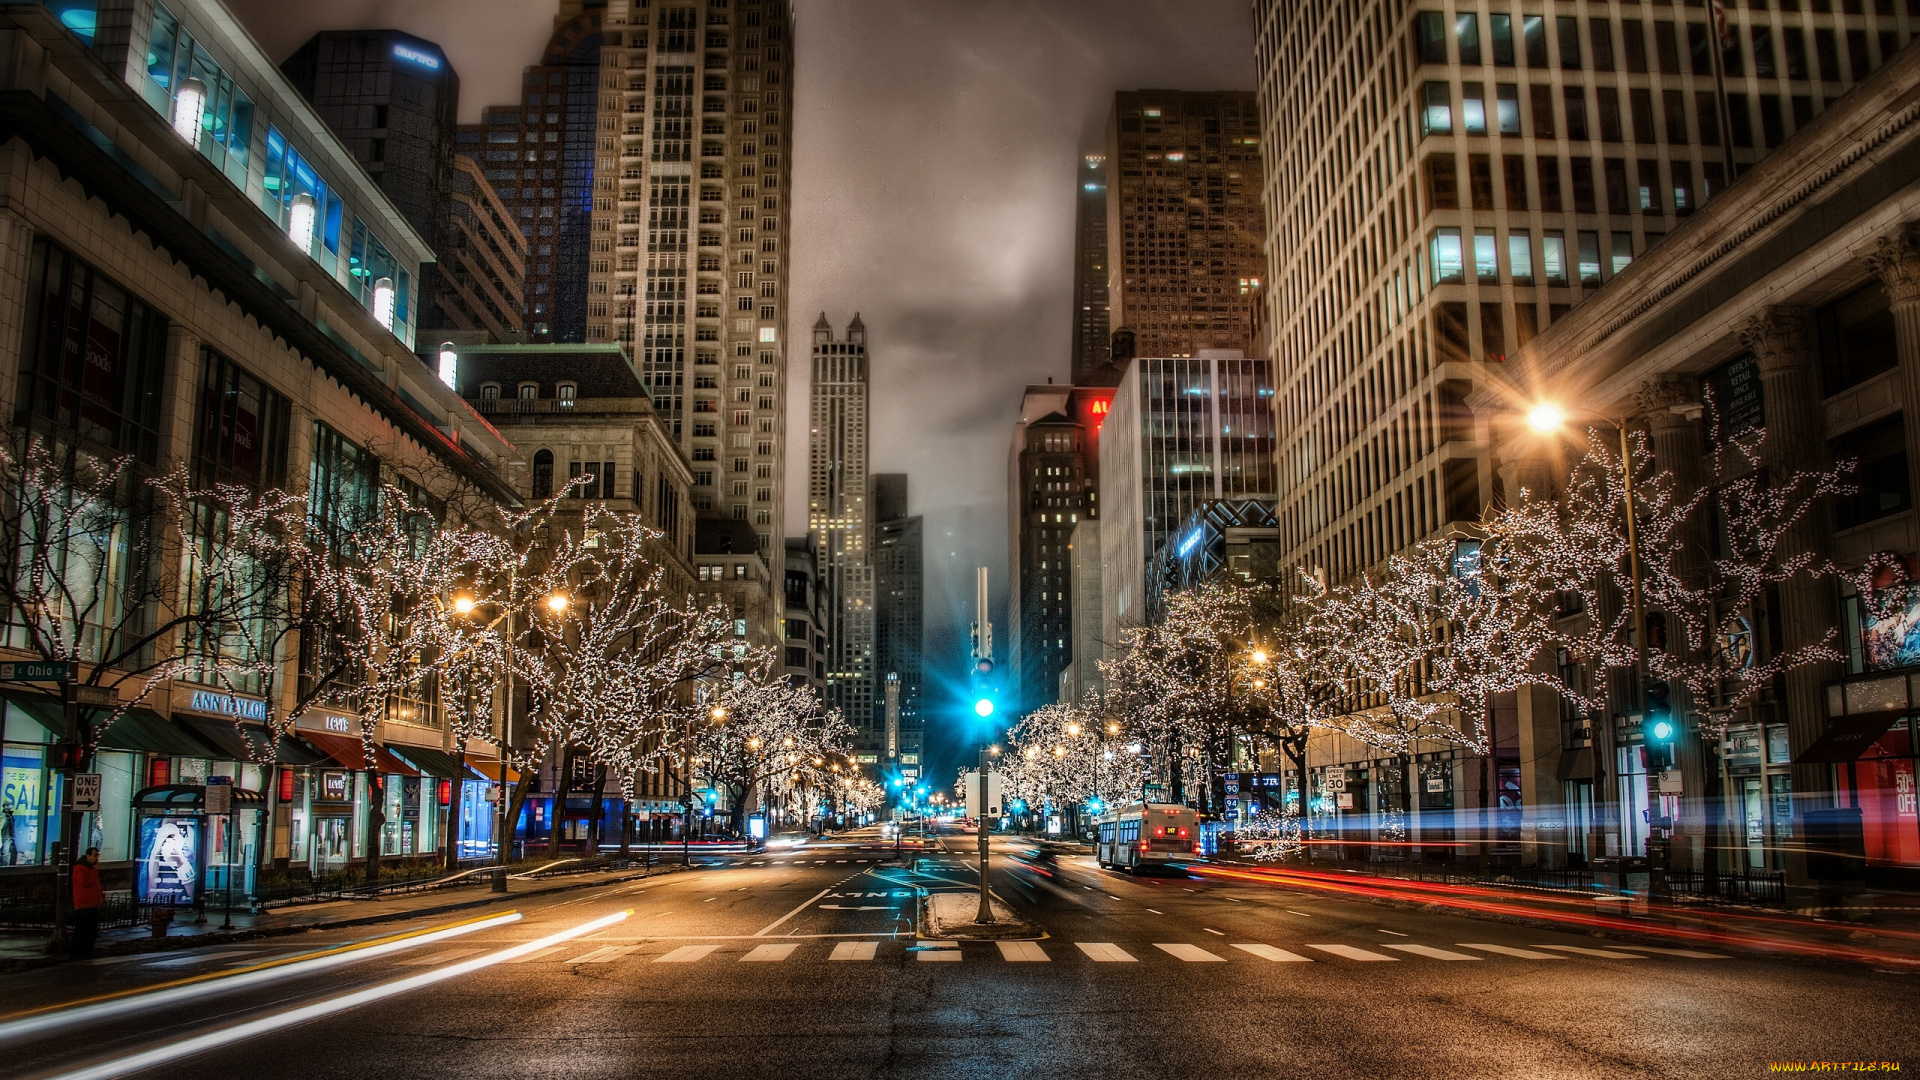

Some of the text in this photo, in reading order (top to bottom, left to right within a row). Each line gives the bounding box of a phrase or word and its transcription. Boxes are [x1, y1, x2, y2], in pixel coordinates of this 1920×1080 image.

[1731, 370, 1751, 387] RETAIL
[27, 665, 53, 676] Ohio
[192, 691, 221, 711] ANN
[77, 776, 98, 787] ONE
[1329, 780, 1343, 788] 30
[1896, 773, 1914, 793] 50%
[76, 787, 97, 797] WAY
[1898, 793, 1917, 812] OFF
